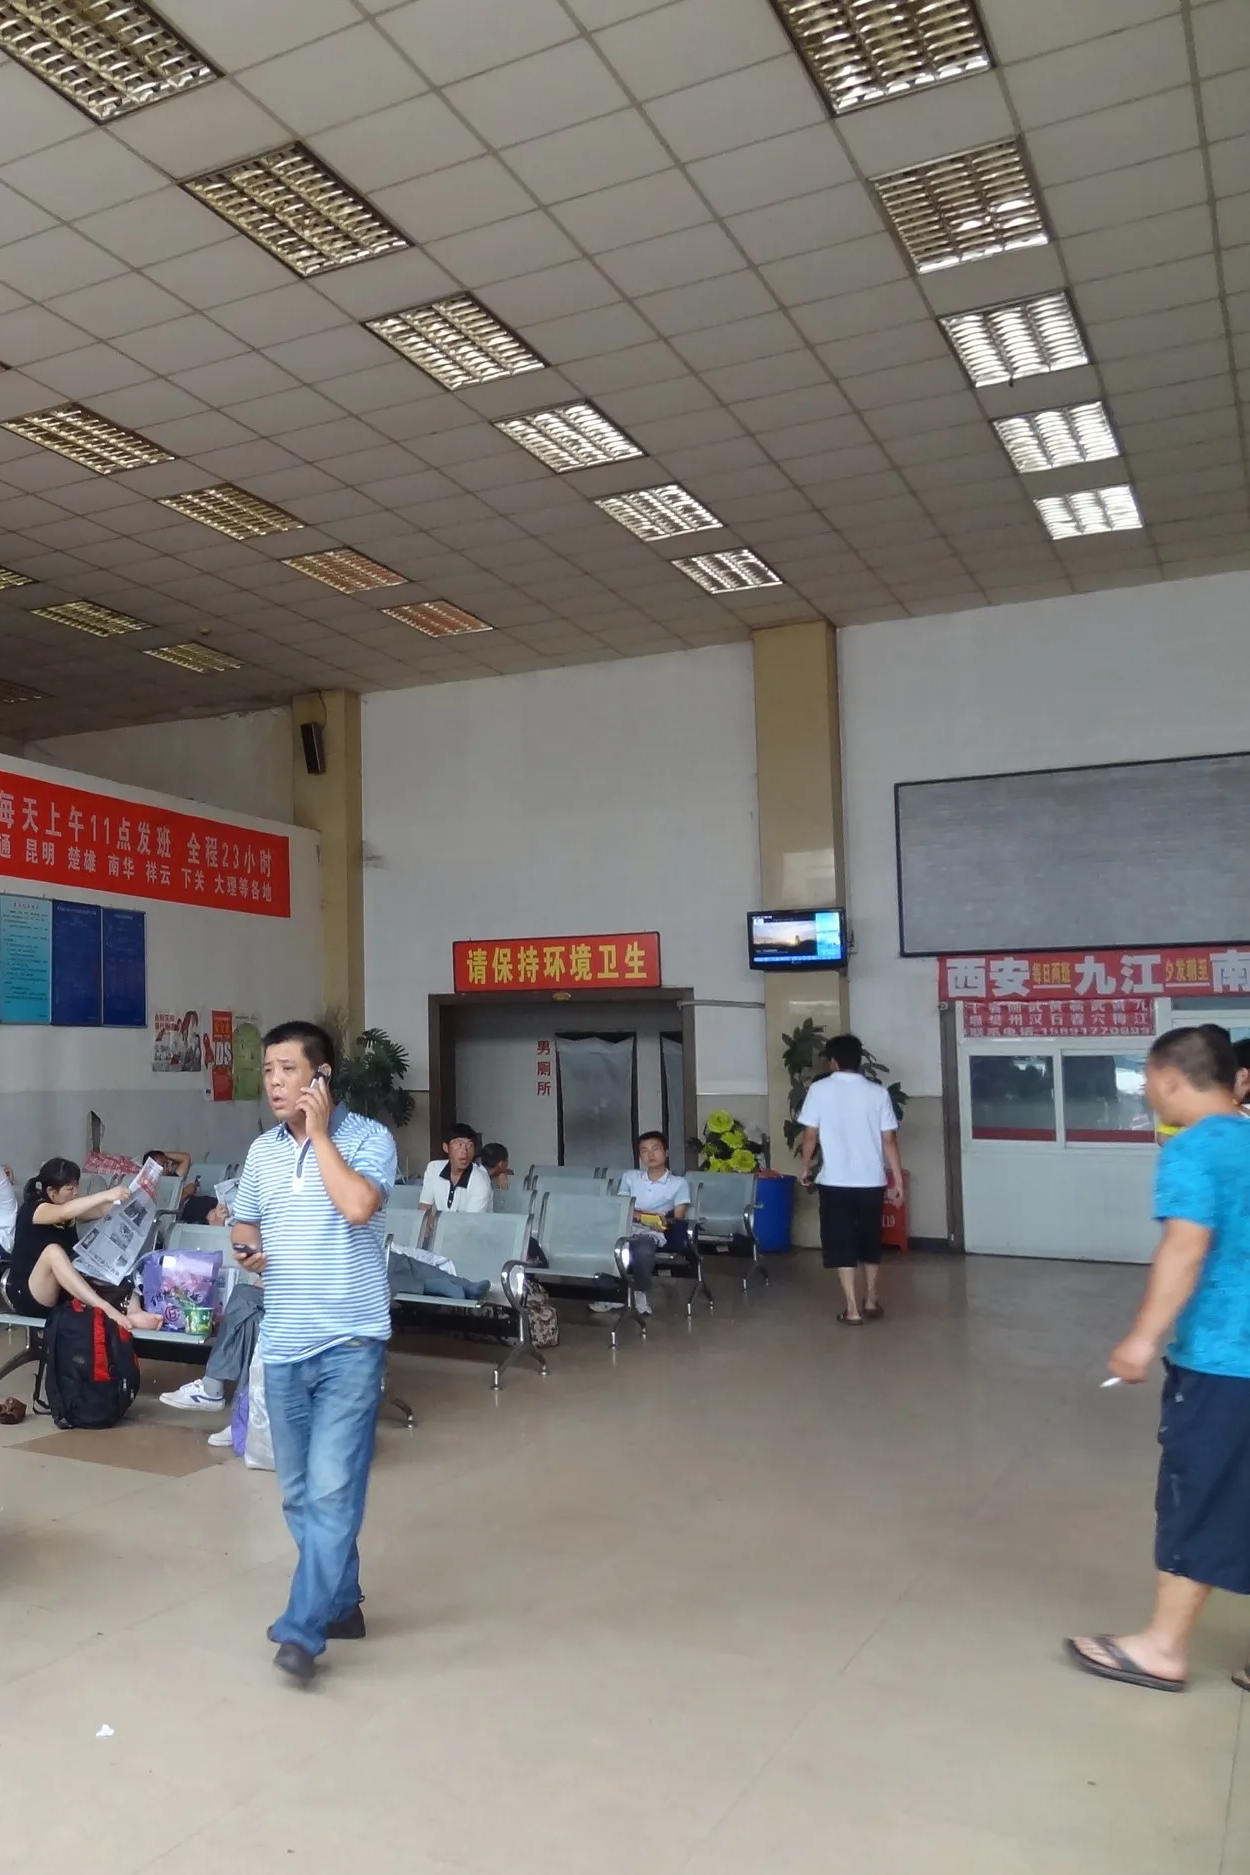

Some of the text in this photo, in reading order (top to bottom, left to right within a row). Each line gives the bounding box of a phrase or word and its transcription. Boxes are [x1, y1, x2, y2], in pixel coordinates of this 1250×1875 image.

[25, 838, 56, 868] 昆明
[67, 845, 97, 874] 楚雄
[108, 853, 135, 881] 南华
[145, 861, 171, 887] 祥云
[181, 868, 205, 893] 下关
[214, 874, 273, 904] 大理等各地
[187, 831, 273, 879] 全程23小时
[466, 941, 648, 984] 请保持环境卫生
[946, 956, 1030, 997] 西安
[1074, 954, 1164, 995] 九江
[1165, 958, 1209, 982] 夕发朝至
[536, 1040, 551, 1097] 男厕所
